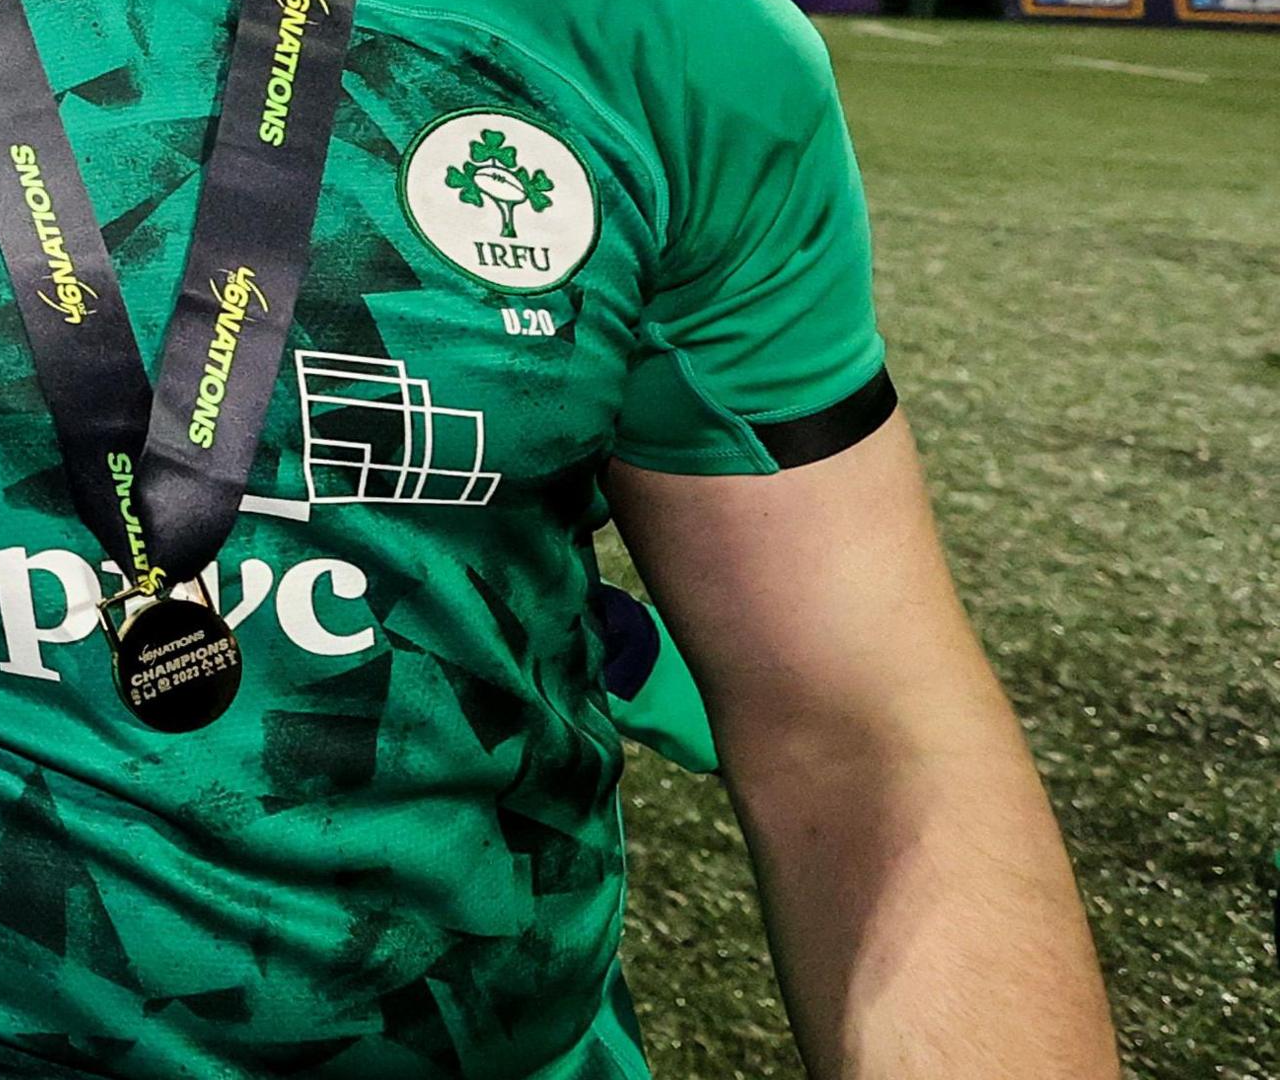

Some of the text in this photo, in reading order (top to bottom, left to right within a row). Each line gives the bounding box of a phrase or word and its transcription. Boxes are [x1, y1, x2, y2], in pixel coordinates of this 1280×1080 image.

[474, 241, 552, 271] IRFU
[500, 308, 556, 336] U.20
[131, 638, 229, 687] CHAMPIONS
[172, 666, 200, 686] 2023
